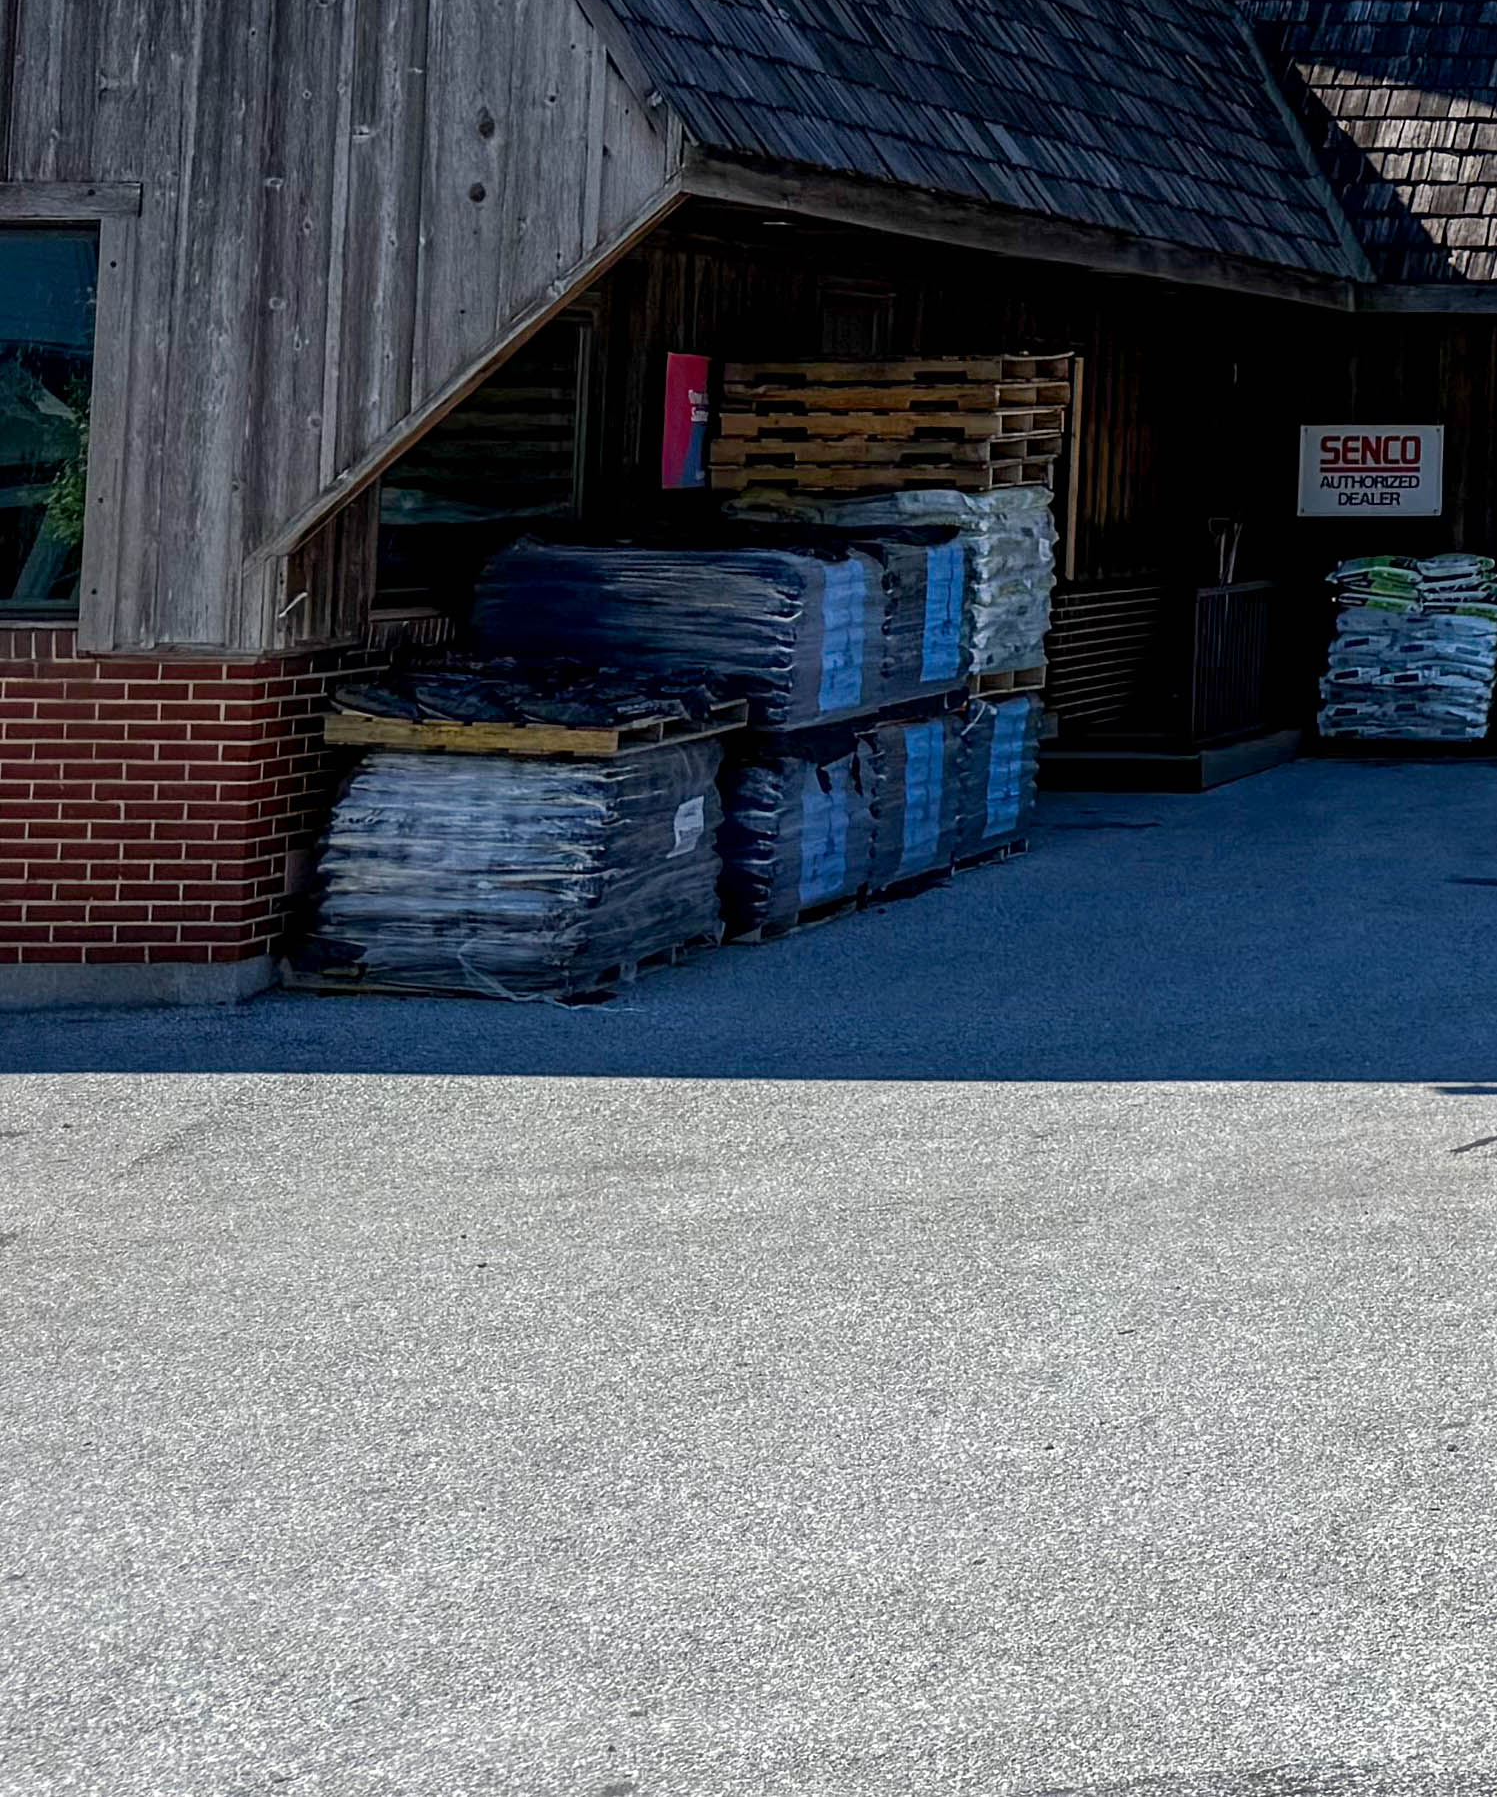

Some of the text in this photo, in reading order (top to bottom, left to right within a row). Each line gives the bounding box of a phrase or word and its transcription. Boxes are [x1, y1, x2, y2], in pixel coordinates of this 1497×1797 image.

[1320, 435, 1421, 465] SENCO
[1320, 474, 1420, 490] AUTHORIZED
[1338, 491, 1402, 506] DEALER
